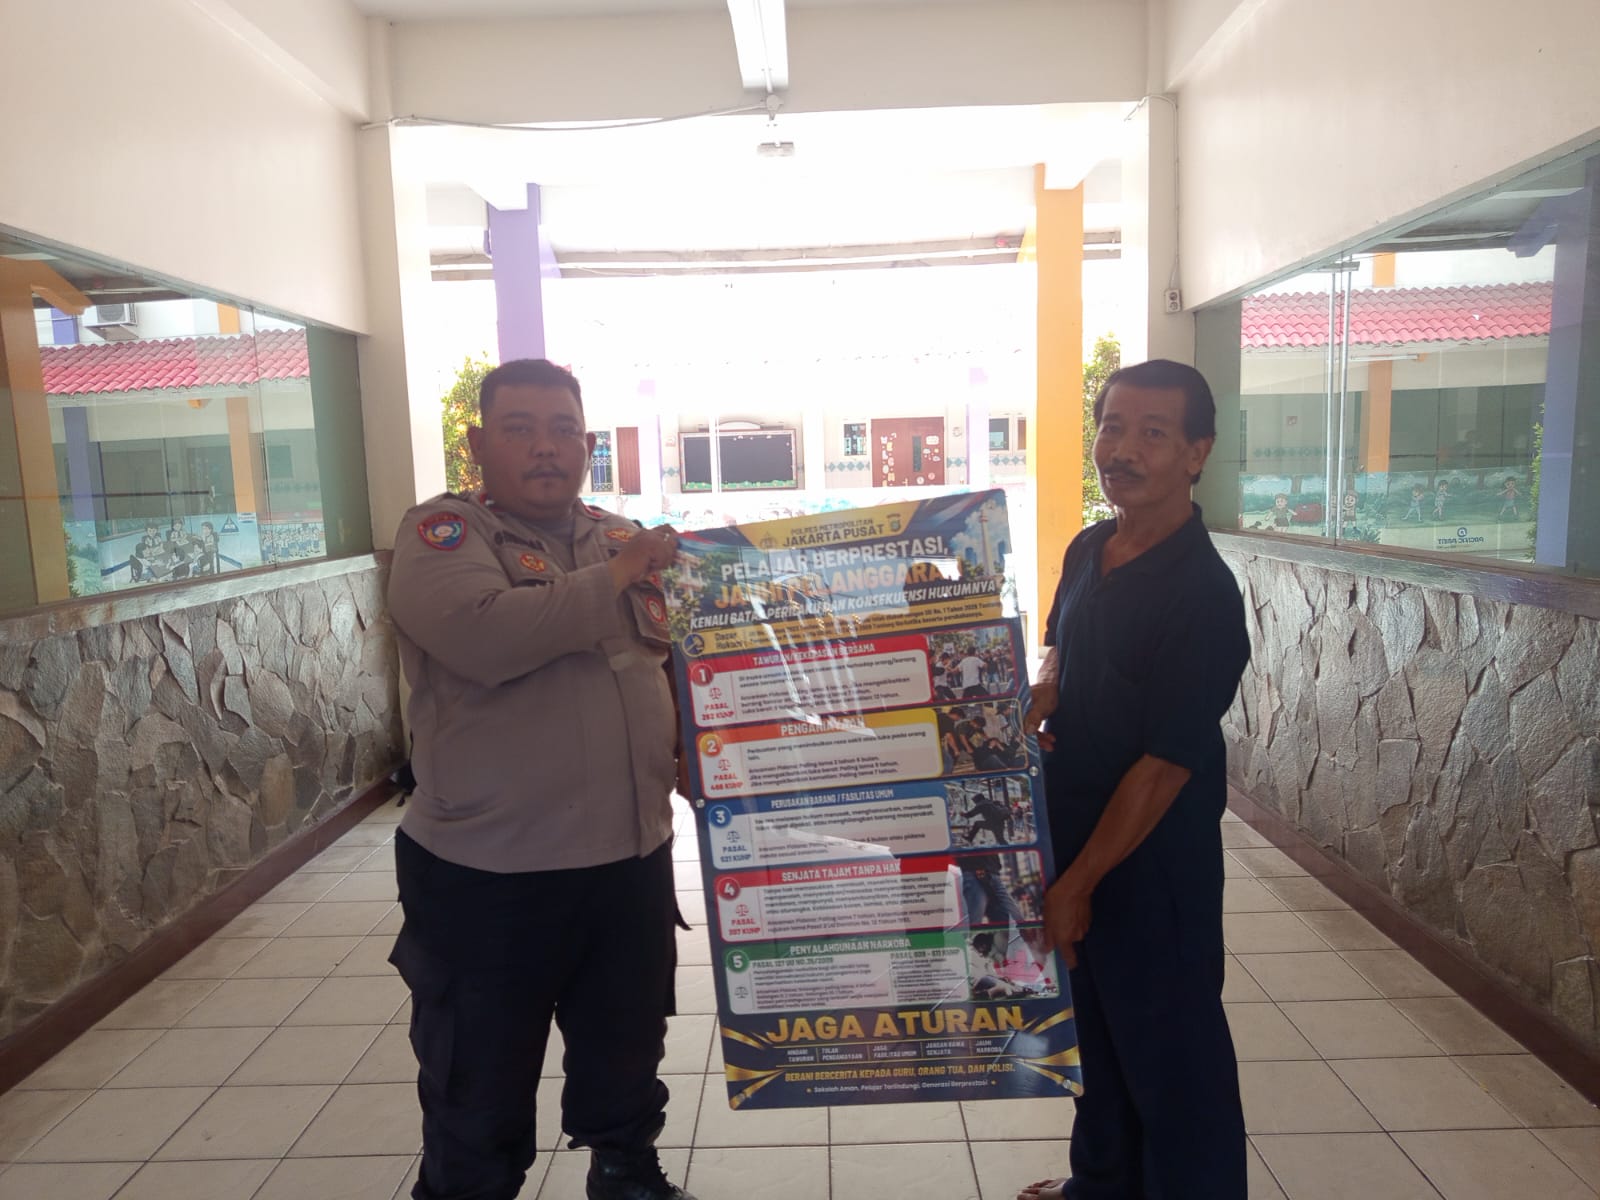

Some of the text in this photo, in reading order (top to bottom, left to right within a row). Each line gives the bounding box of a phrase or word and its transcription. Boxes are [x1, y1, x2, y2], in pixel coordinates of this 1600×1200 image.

[790, 517, 873, 535] POLRES METROPOLITAN
[781, 523, 885, 547] JAKARTA PUSAT
[720, 534, 948, 582] PELAJAR BERPRESTASI,
[689, 612, 728, 628] KENALI
[846, 588, 926, 610] KONSEKUENSI
[927, 580, 996, 600] HUKUMNYA
[698, 669, 706, 682] 1
[703, 701, 728, 710] PASAL
[706, 740, 717, 753] 2
[713, 772, 737, 781] PASAL
[840, 790, 874, 802] FASILITAS
[715, 810, 726, 823] 3
[722, 844, 746, 852] PASAL
[781, 863, 901, 881] SENJATA TAJAM TANPA HAK
[723, 882, 735, 896] 4
[731, 917, 755, 925] PASAL
[789, 938, 911, 955] PENYALAHGUNAAN NARKOBA
[732, 955, 743, 968] 5
[764, 1006, 1023, 1042] JAGA ATURAN
[784, 1063, 1016, 1081] BERANI BERCERITA KEPADA GURU, ORANG TUA, DAN POLISI.
[883, 1082, 920, 1091] Terlindungi,
[921, 1081, 950, 1089] Generasi
[950, 1080, 988, 1088] Berprestasi
